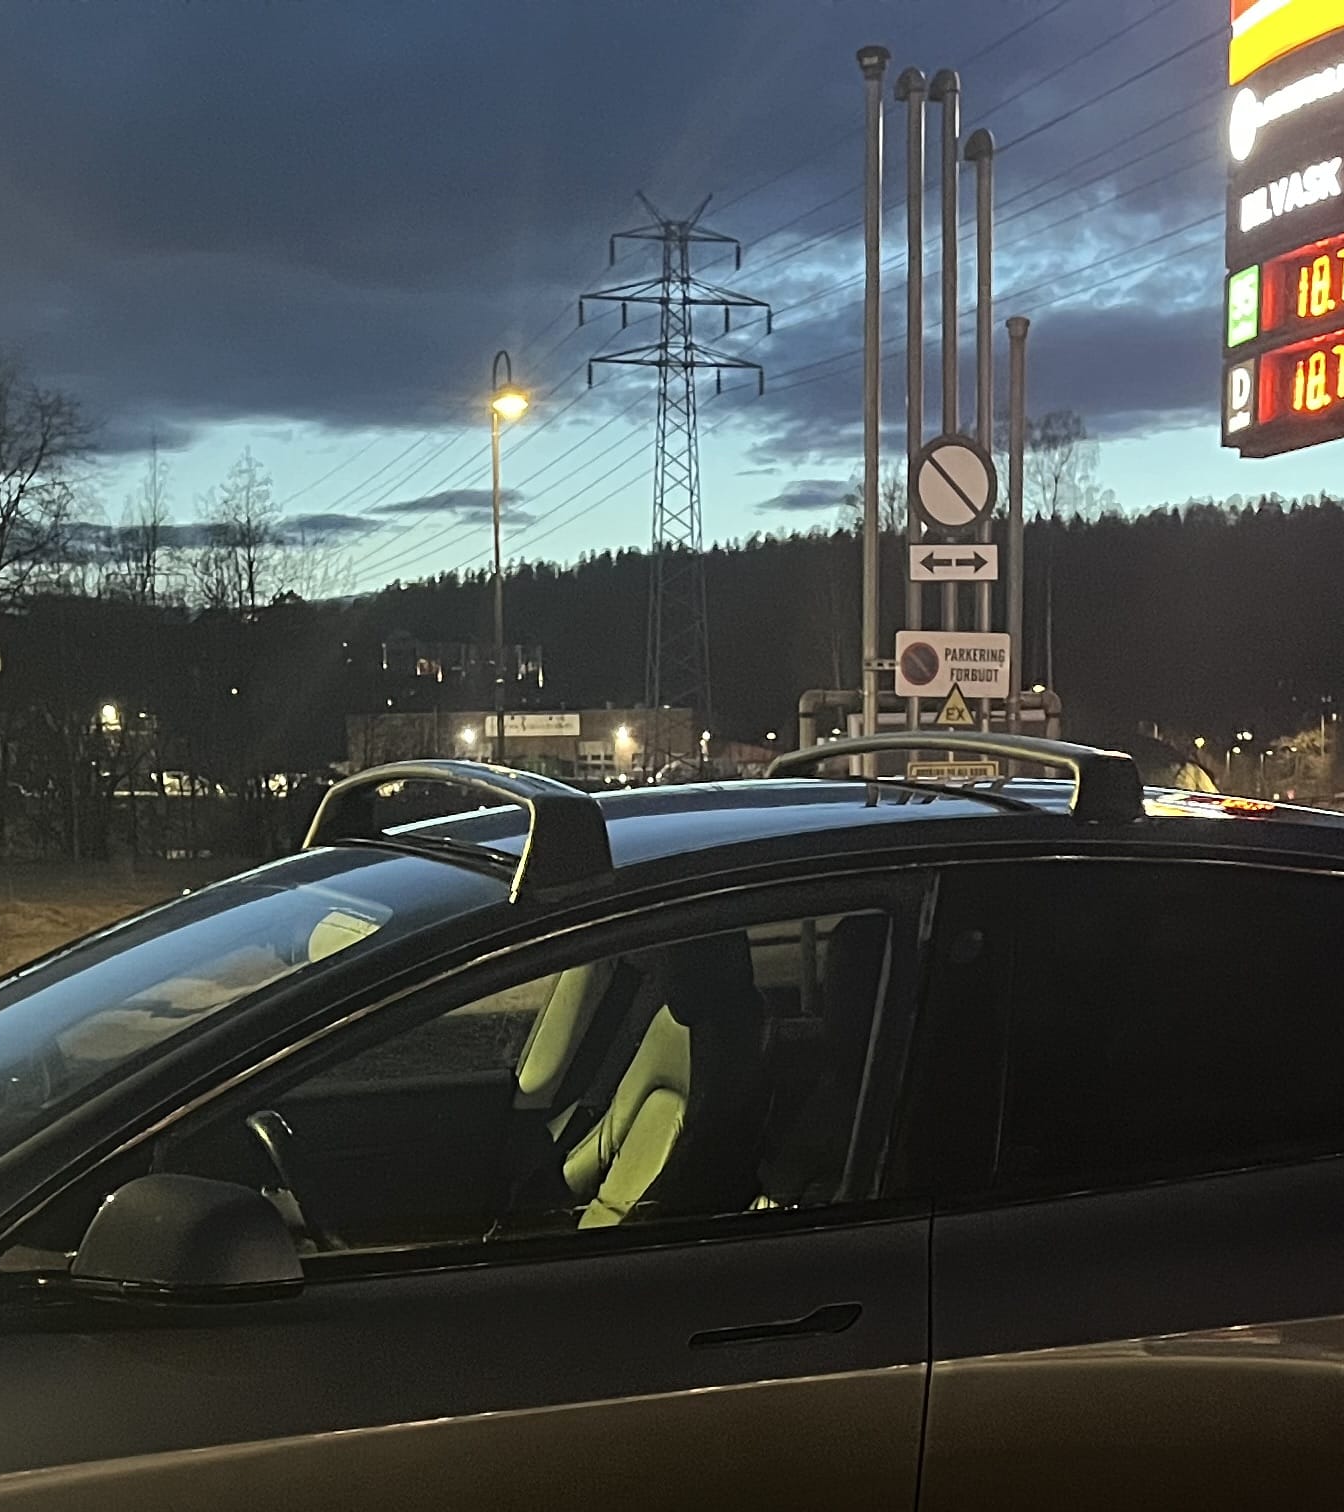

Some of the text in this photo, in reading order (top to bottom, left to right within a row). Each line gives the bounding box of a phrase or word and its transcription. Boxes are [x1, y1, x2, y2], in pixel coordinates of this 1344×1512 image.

[944, 647, 1006, 663] PARKERING
[950, 668, 1000, 683] FORBUDT
[945, 707, 965, 721] EX
